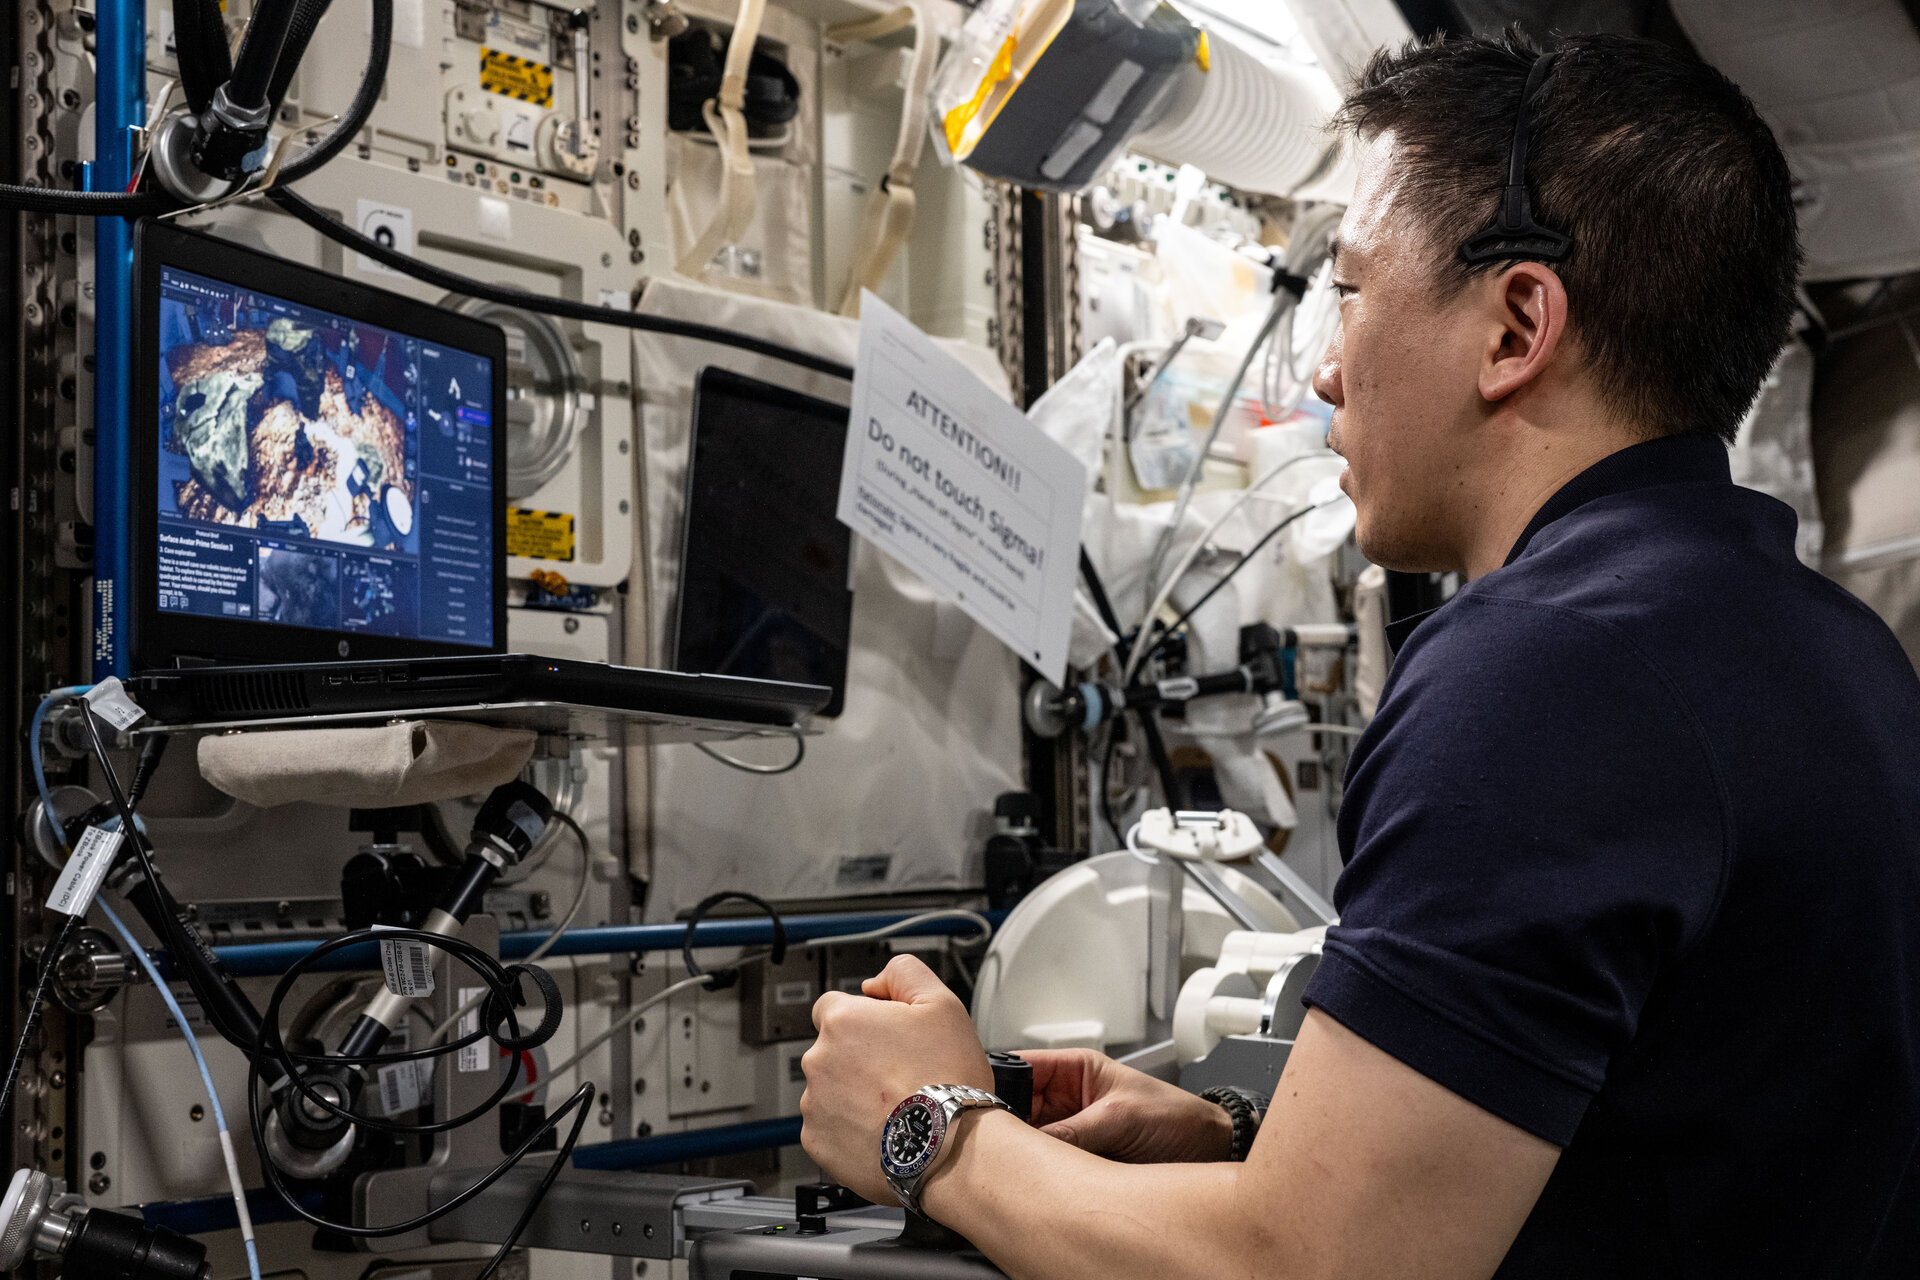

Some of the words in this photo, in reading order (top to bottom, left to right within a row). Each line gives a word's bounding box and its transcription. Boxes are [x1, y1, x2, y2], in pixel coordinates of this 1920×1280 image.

[906, 390, 1021, 493] ATTENTION!!
[868, 417, 894, 452] Do
[900, 446, 930, 482] not
[936, 470, 985, 522] touch
[989, 510, 1044, 571] Sigma!
[160, 533, 179, 544] Surface
[179, 536, 196, 547] Avatar
[196, 538, 210, 549] Prime
[211, 541, 229, 551] Session
[175, 549, 197, 557] exploration
[160, 556, 171, 565] There
[233, 567, 247, 575] surface
[160, 564, 174, 572] habitat.
[88, 828, 96, 836] To
[90, 830, 104, 850] ZBook
[77, 837, 91, 857] ZBook
[79, 852, 92, 872] Power
[68, 873, 81, 891] Cable
[58, 892, 70, 907] (DC)
[925, 1098, 933, 1106] 12
[912, 1158, 924, 1170] 20
